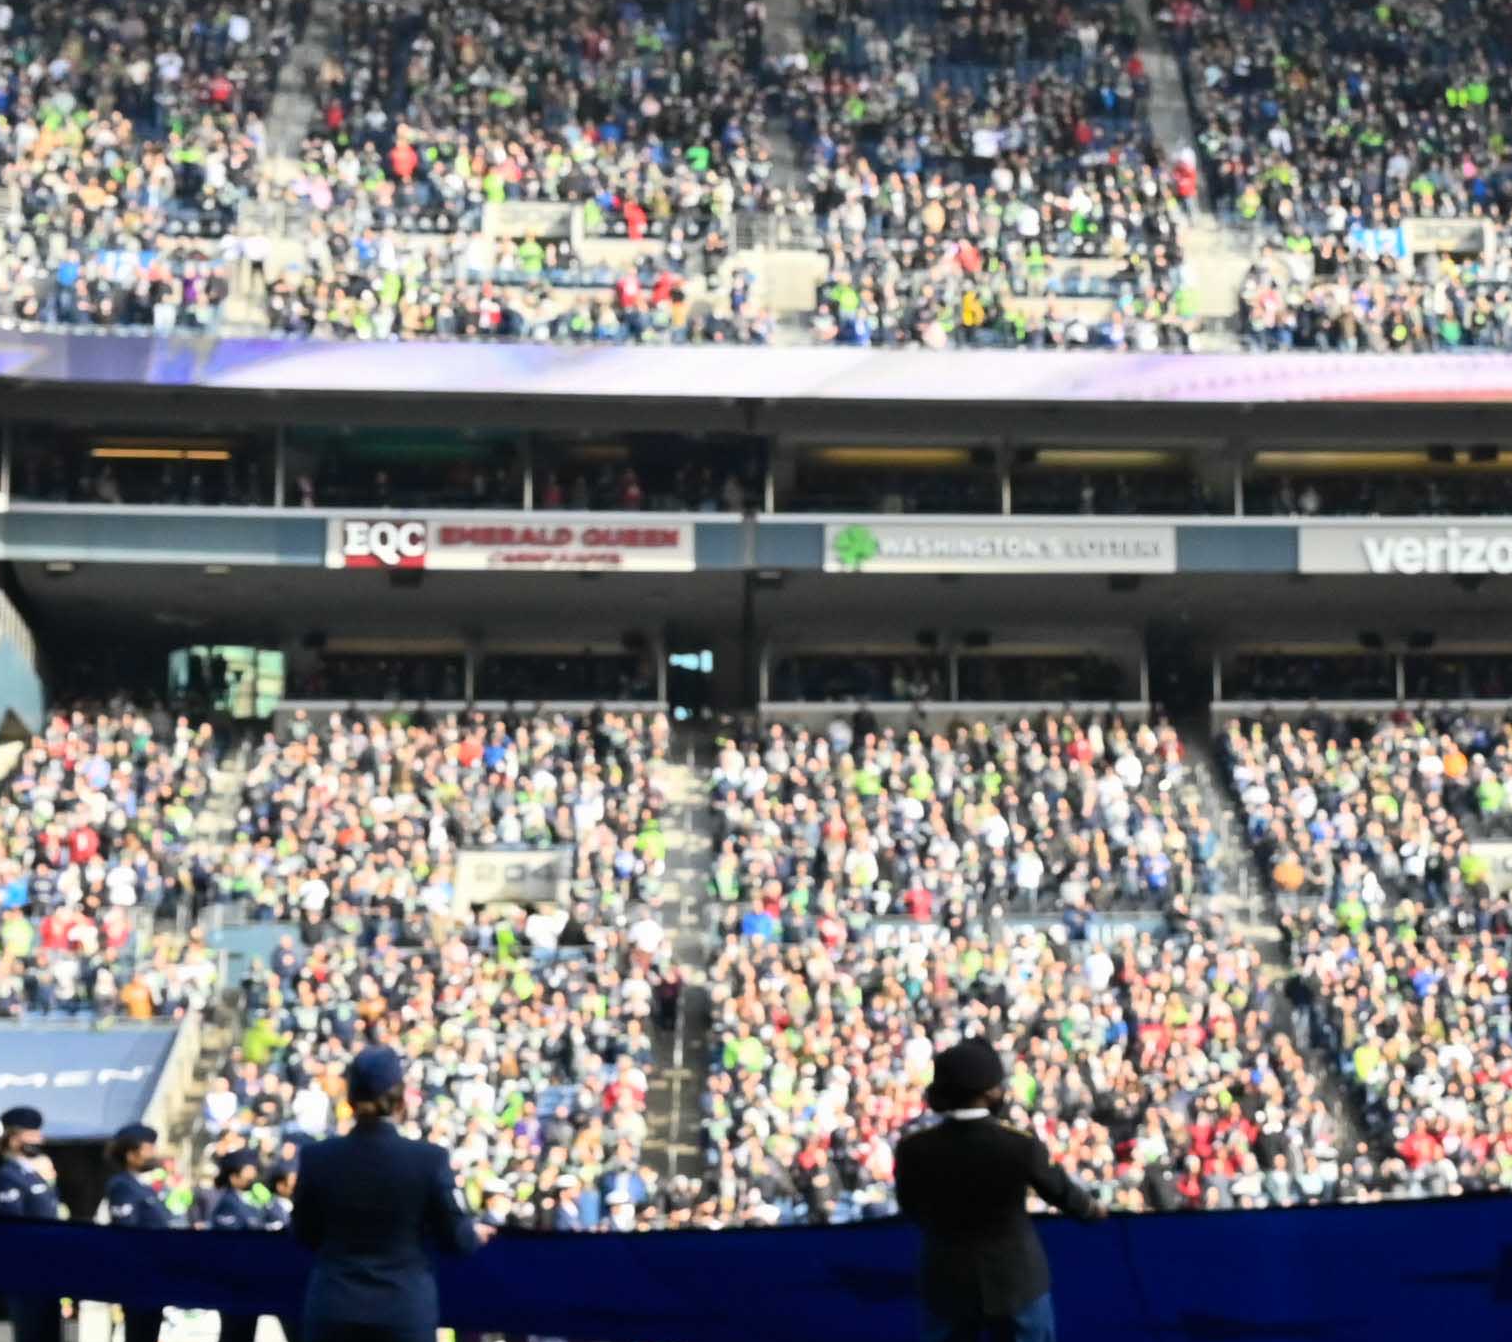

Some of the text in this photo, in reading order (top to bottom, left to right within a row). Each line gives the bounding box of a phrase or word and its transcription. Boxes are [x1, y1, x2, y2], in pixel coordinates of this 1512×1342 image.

[343, 521, 426, 565] EQC
[439, 526, 680, 548] EMERALD QUEEN
